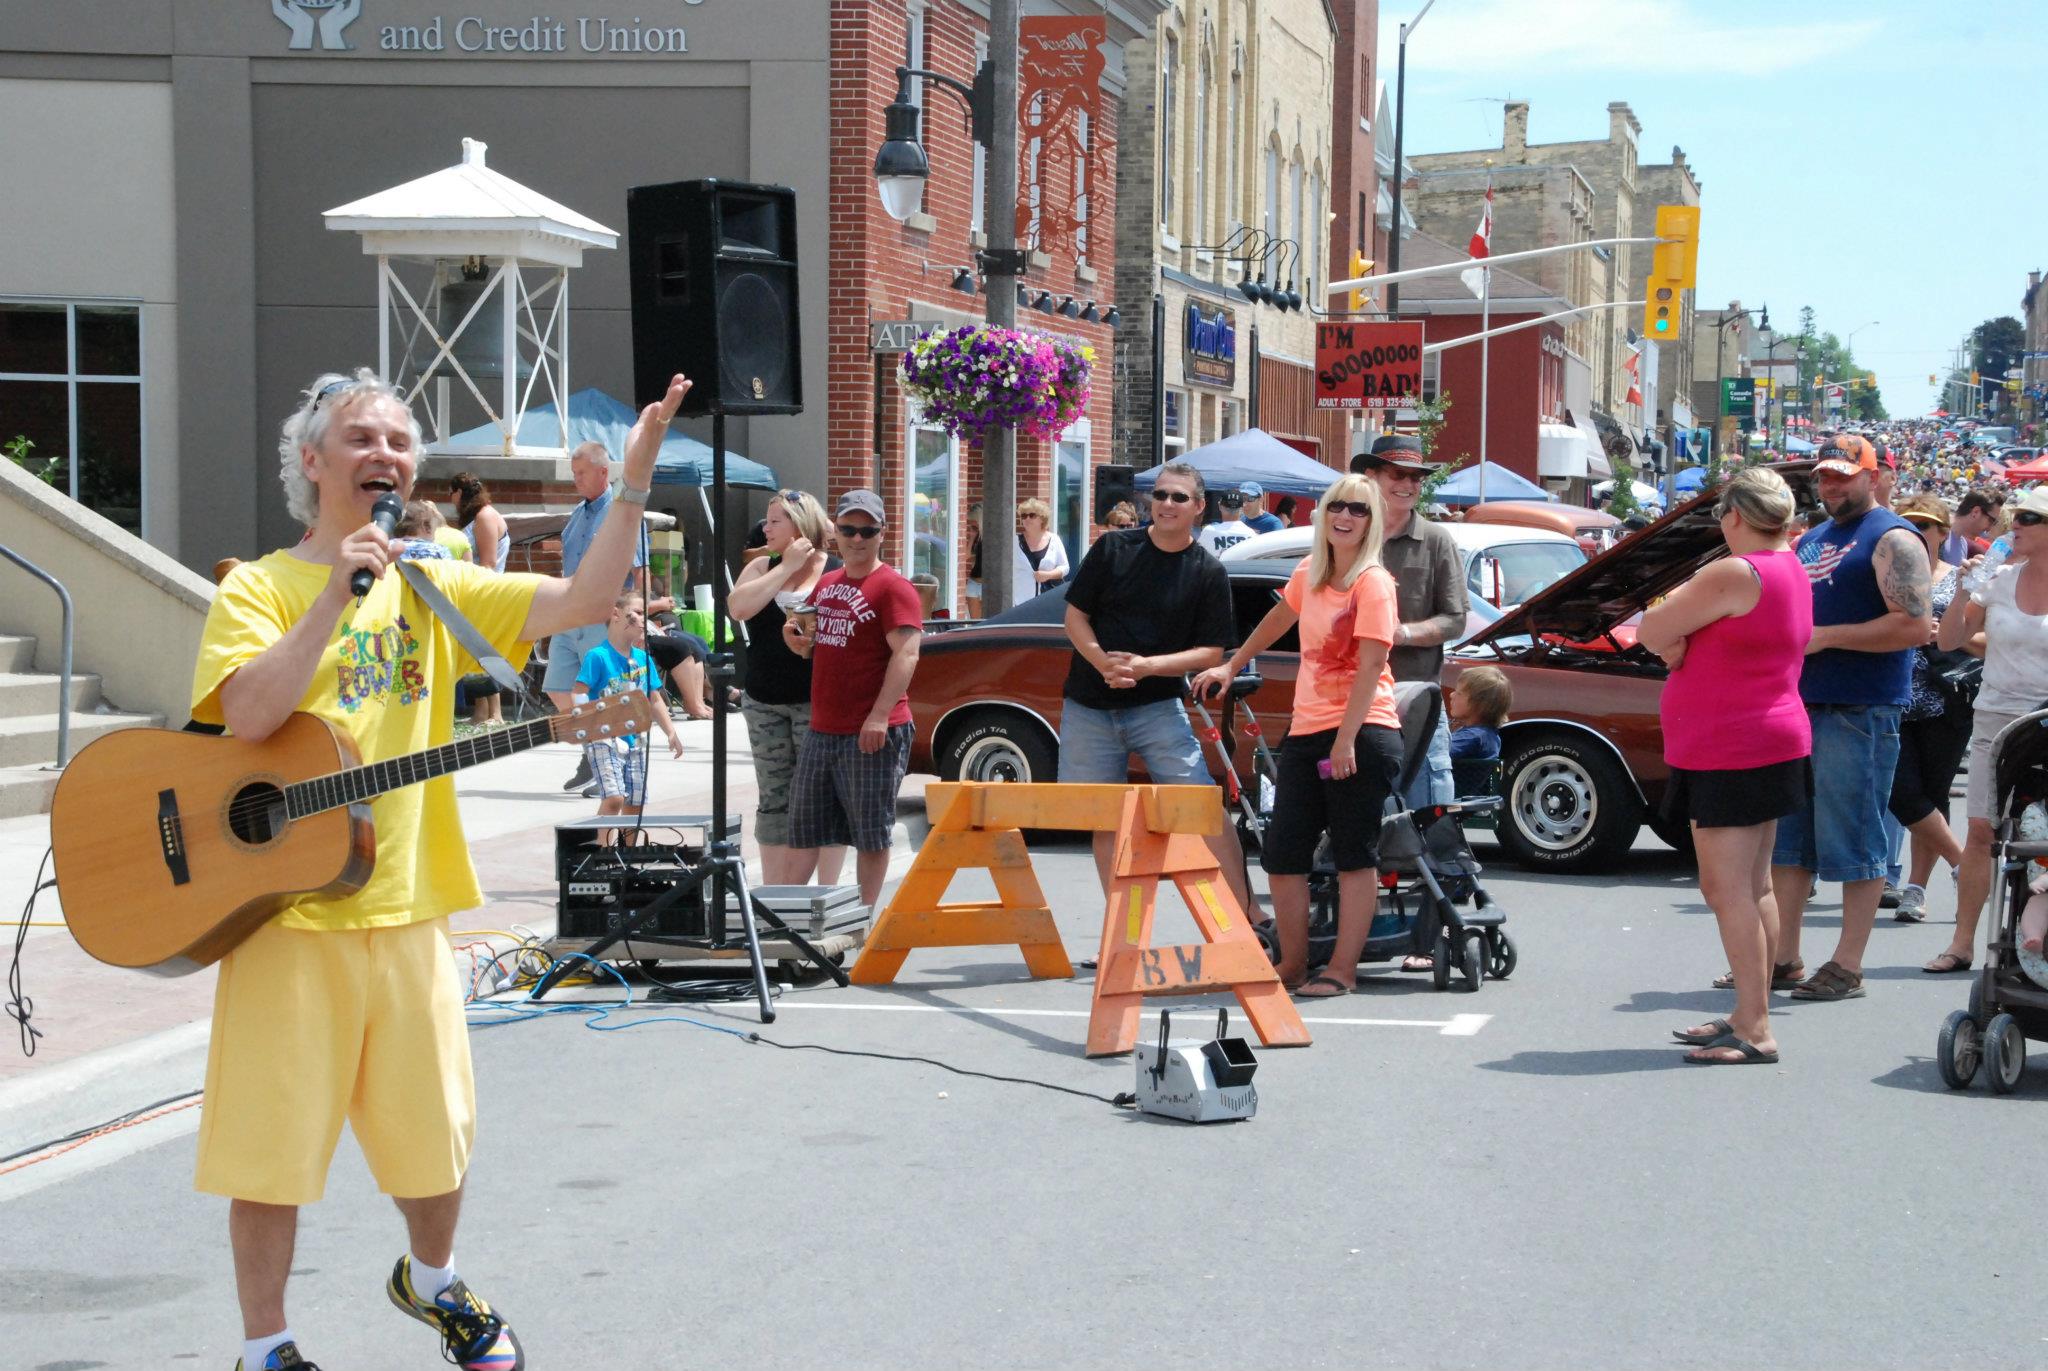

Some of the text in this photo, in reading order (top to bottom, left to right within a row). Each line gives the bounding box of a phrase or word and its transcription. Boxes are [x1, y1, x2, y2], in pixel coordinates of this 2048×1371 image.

[380, 16, 688, 52] and Credit Union
[1319, 326, 1354, 349] I'M
[1363, 372, 1420, 397] BAD!
[1317, 398, 1339, 408] ADULT
[1340, 398, 1362, 408] STORE
[1367, 398, 1384, 408] (519)
[827, 617, 856, 637] YORK
[354, 625, 404, 665] KID
[954, 726, 1008, 758] Radial T/A
[1556, 837, 1595, 860] Radial
